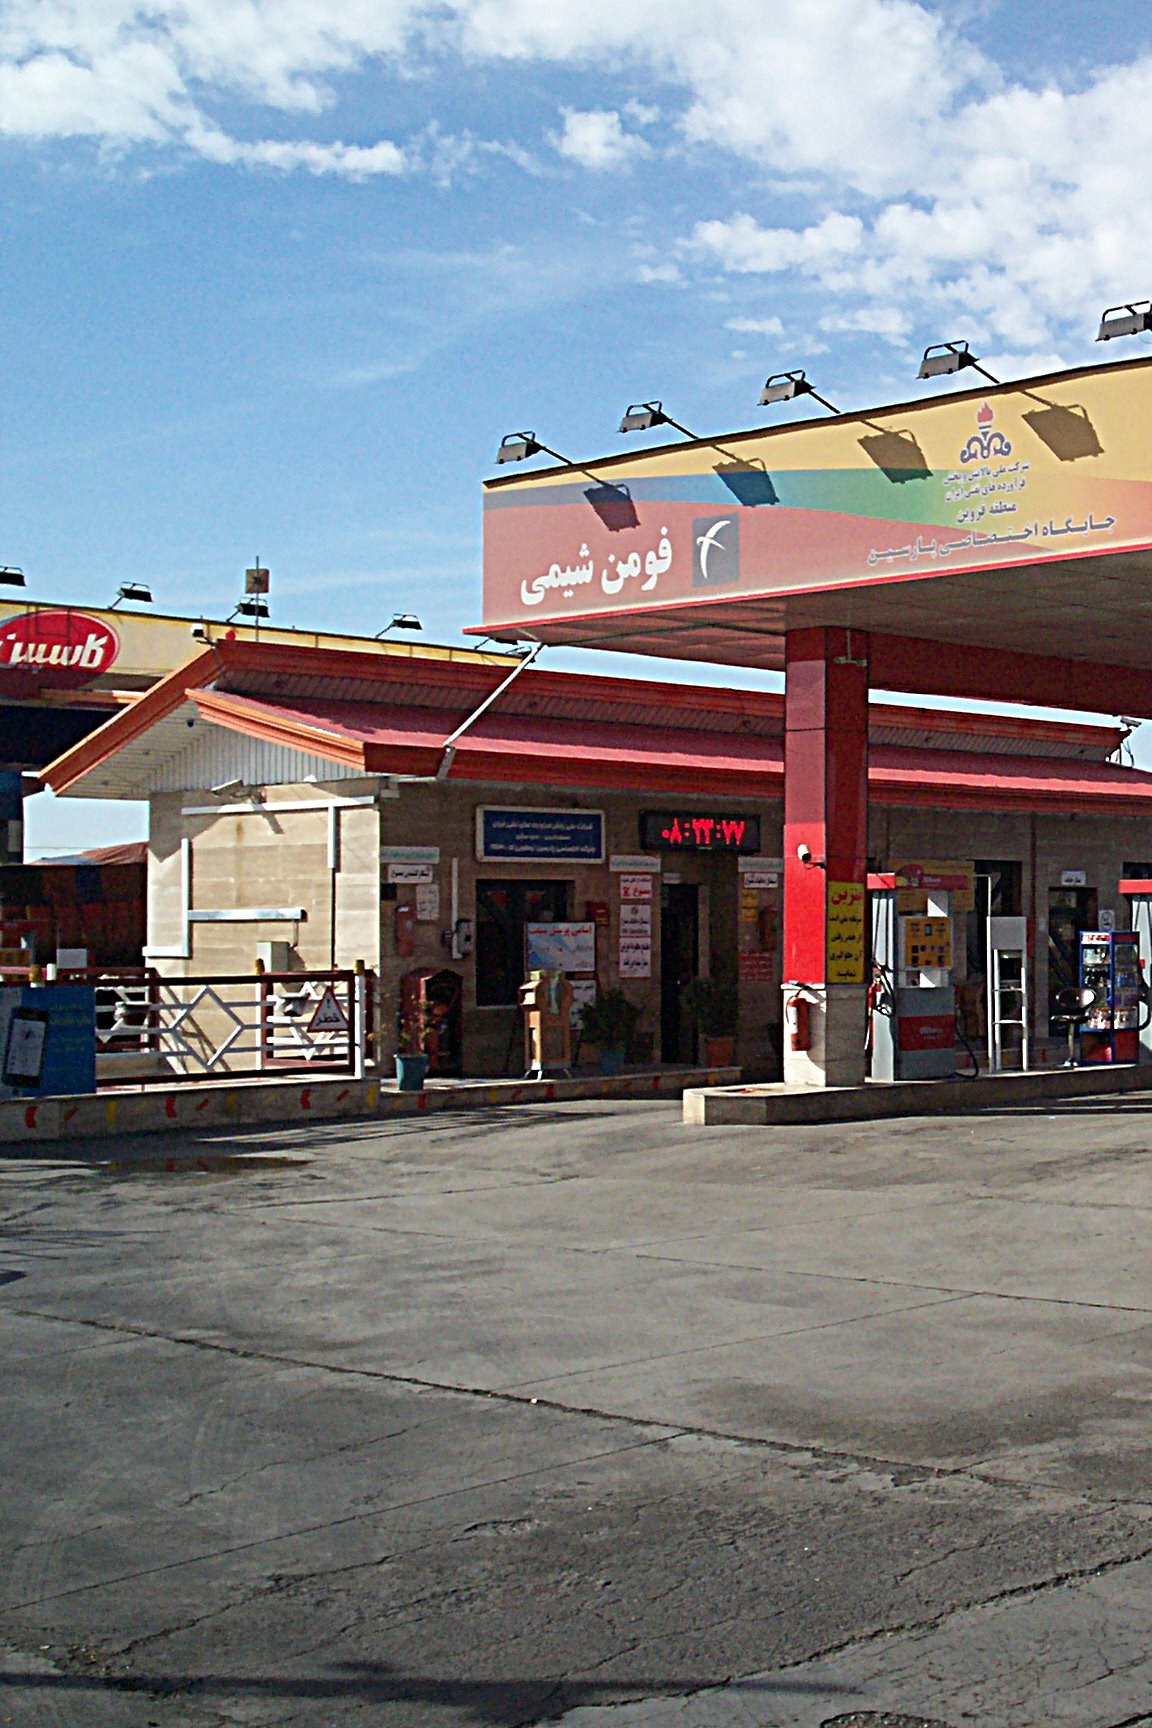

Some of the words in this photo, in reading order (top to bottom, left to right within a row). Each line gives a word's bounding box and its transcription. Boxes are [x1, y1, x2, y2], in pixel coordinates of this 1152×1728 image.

[939, 523, 1038, 556] اختصاصی
[1042, 513, 1116, 537] جایگاه
[520, 542, 594, 606] شیمی
[601, 526, 673, 595] فومن
